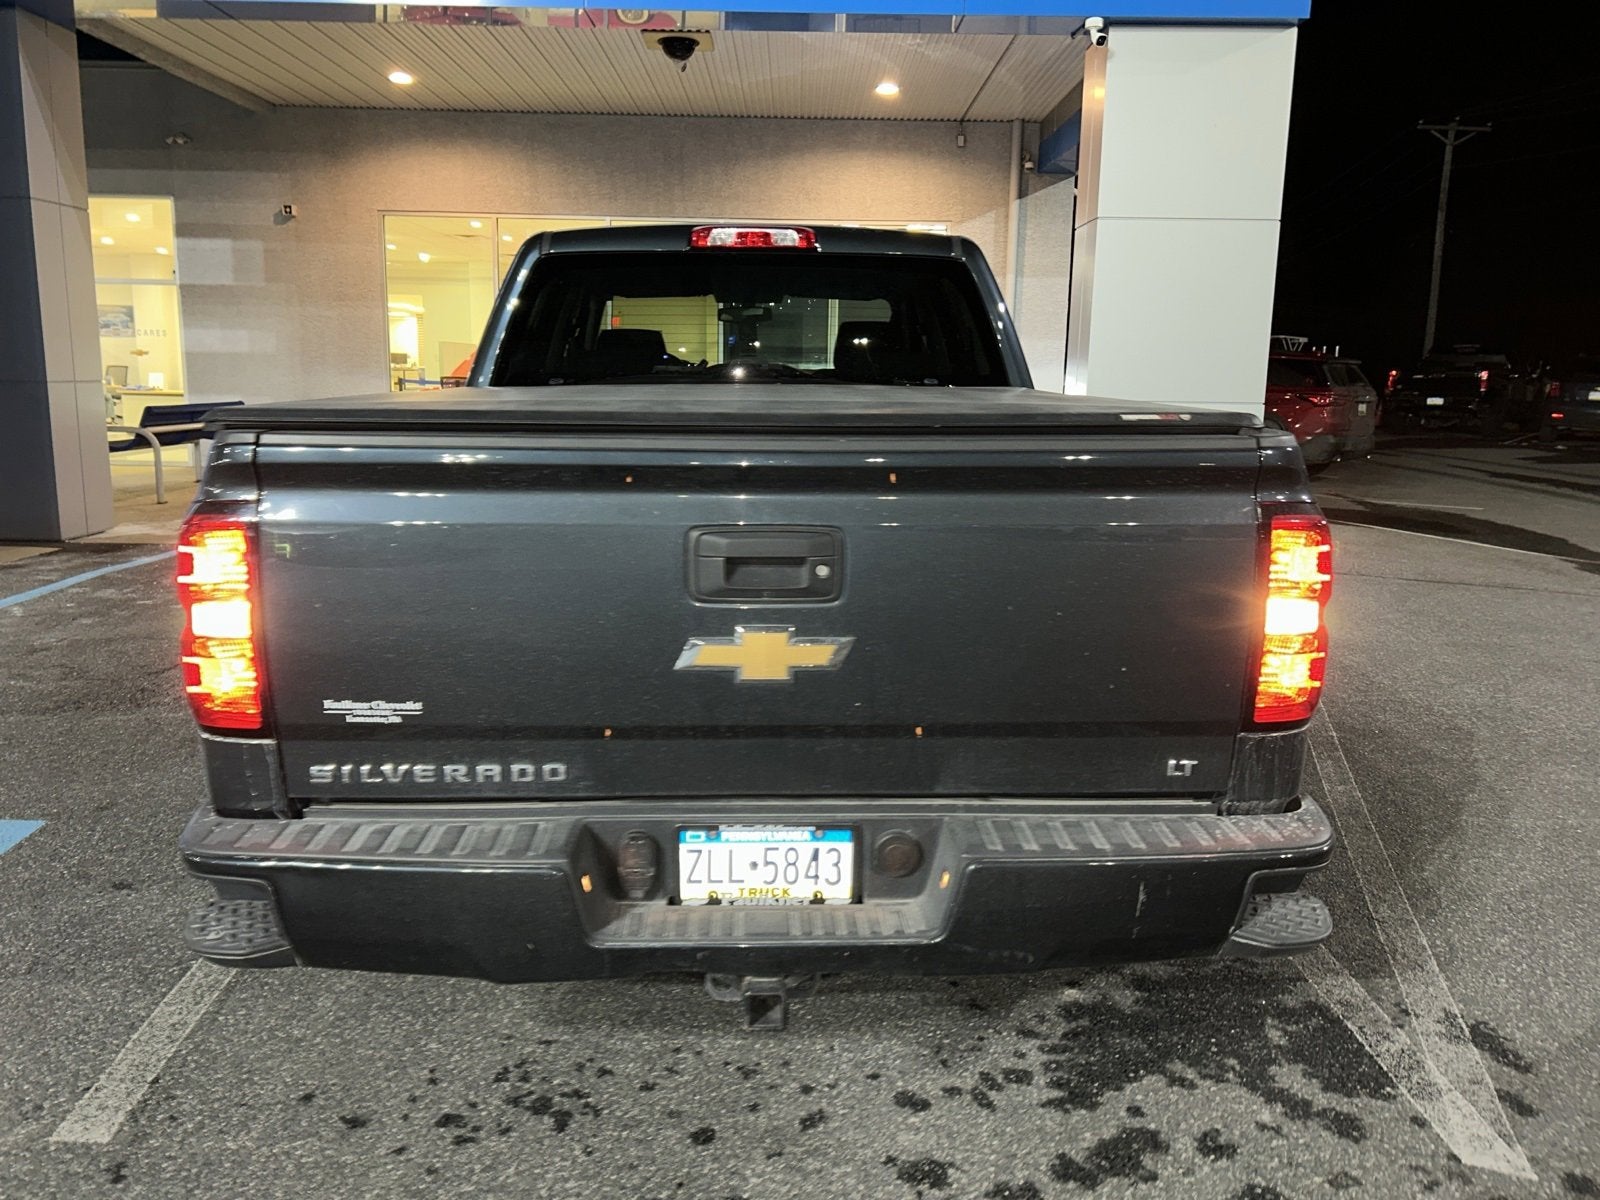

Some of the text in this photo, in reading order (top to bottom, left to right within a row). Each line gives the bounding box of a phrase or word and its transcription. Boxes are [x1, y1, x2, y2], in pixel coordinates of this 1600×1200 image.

[136, 328, 168, 337] CARES
[308, 763, 568, 783] SILVERADO
[1166, 759, 1199, 777] LT
[738, 887, 791, 898] TRUCK
